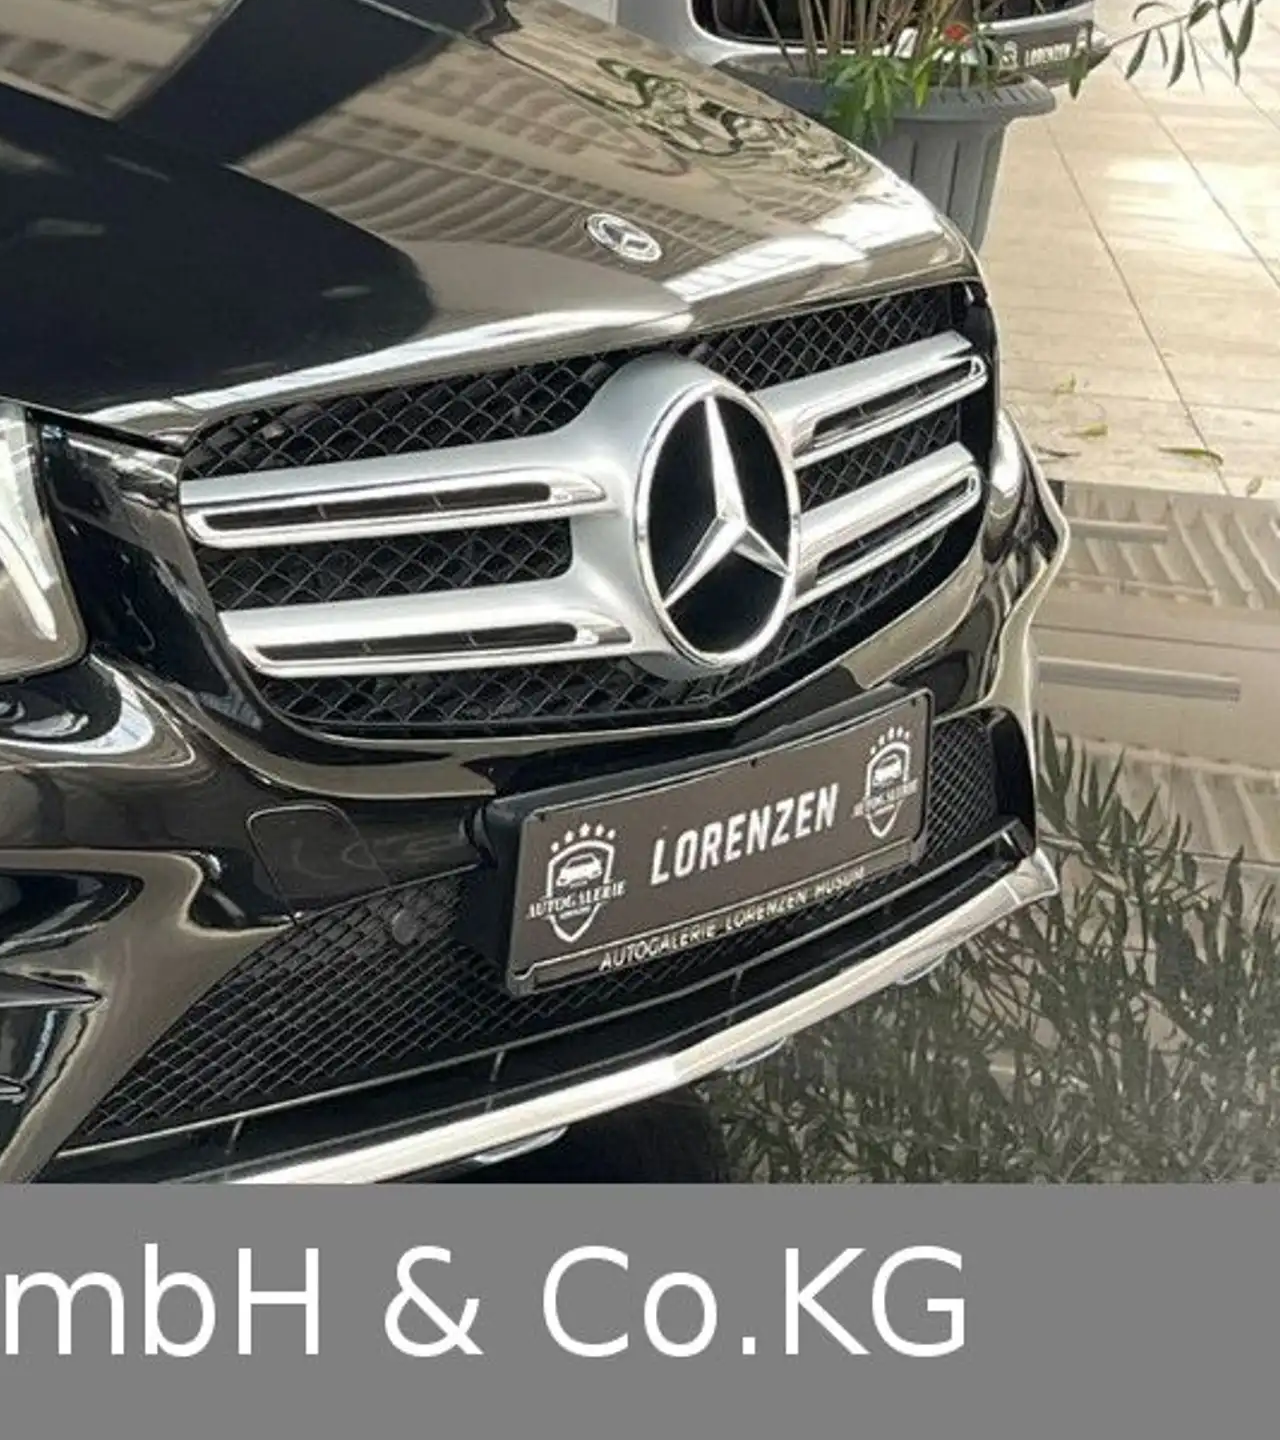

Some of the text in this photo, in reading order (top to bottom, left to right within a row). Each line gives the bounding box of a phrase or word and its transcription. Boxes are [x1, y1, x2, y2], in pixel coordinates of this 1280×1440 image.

[650, 782, 839, 886] LORENZEN
[598, 921, 717, 972] AUTOGALERIE
[725, 888, 809, 931] LORENZEN
